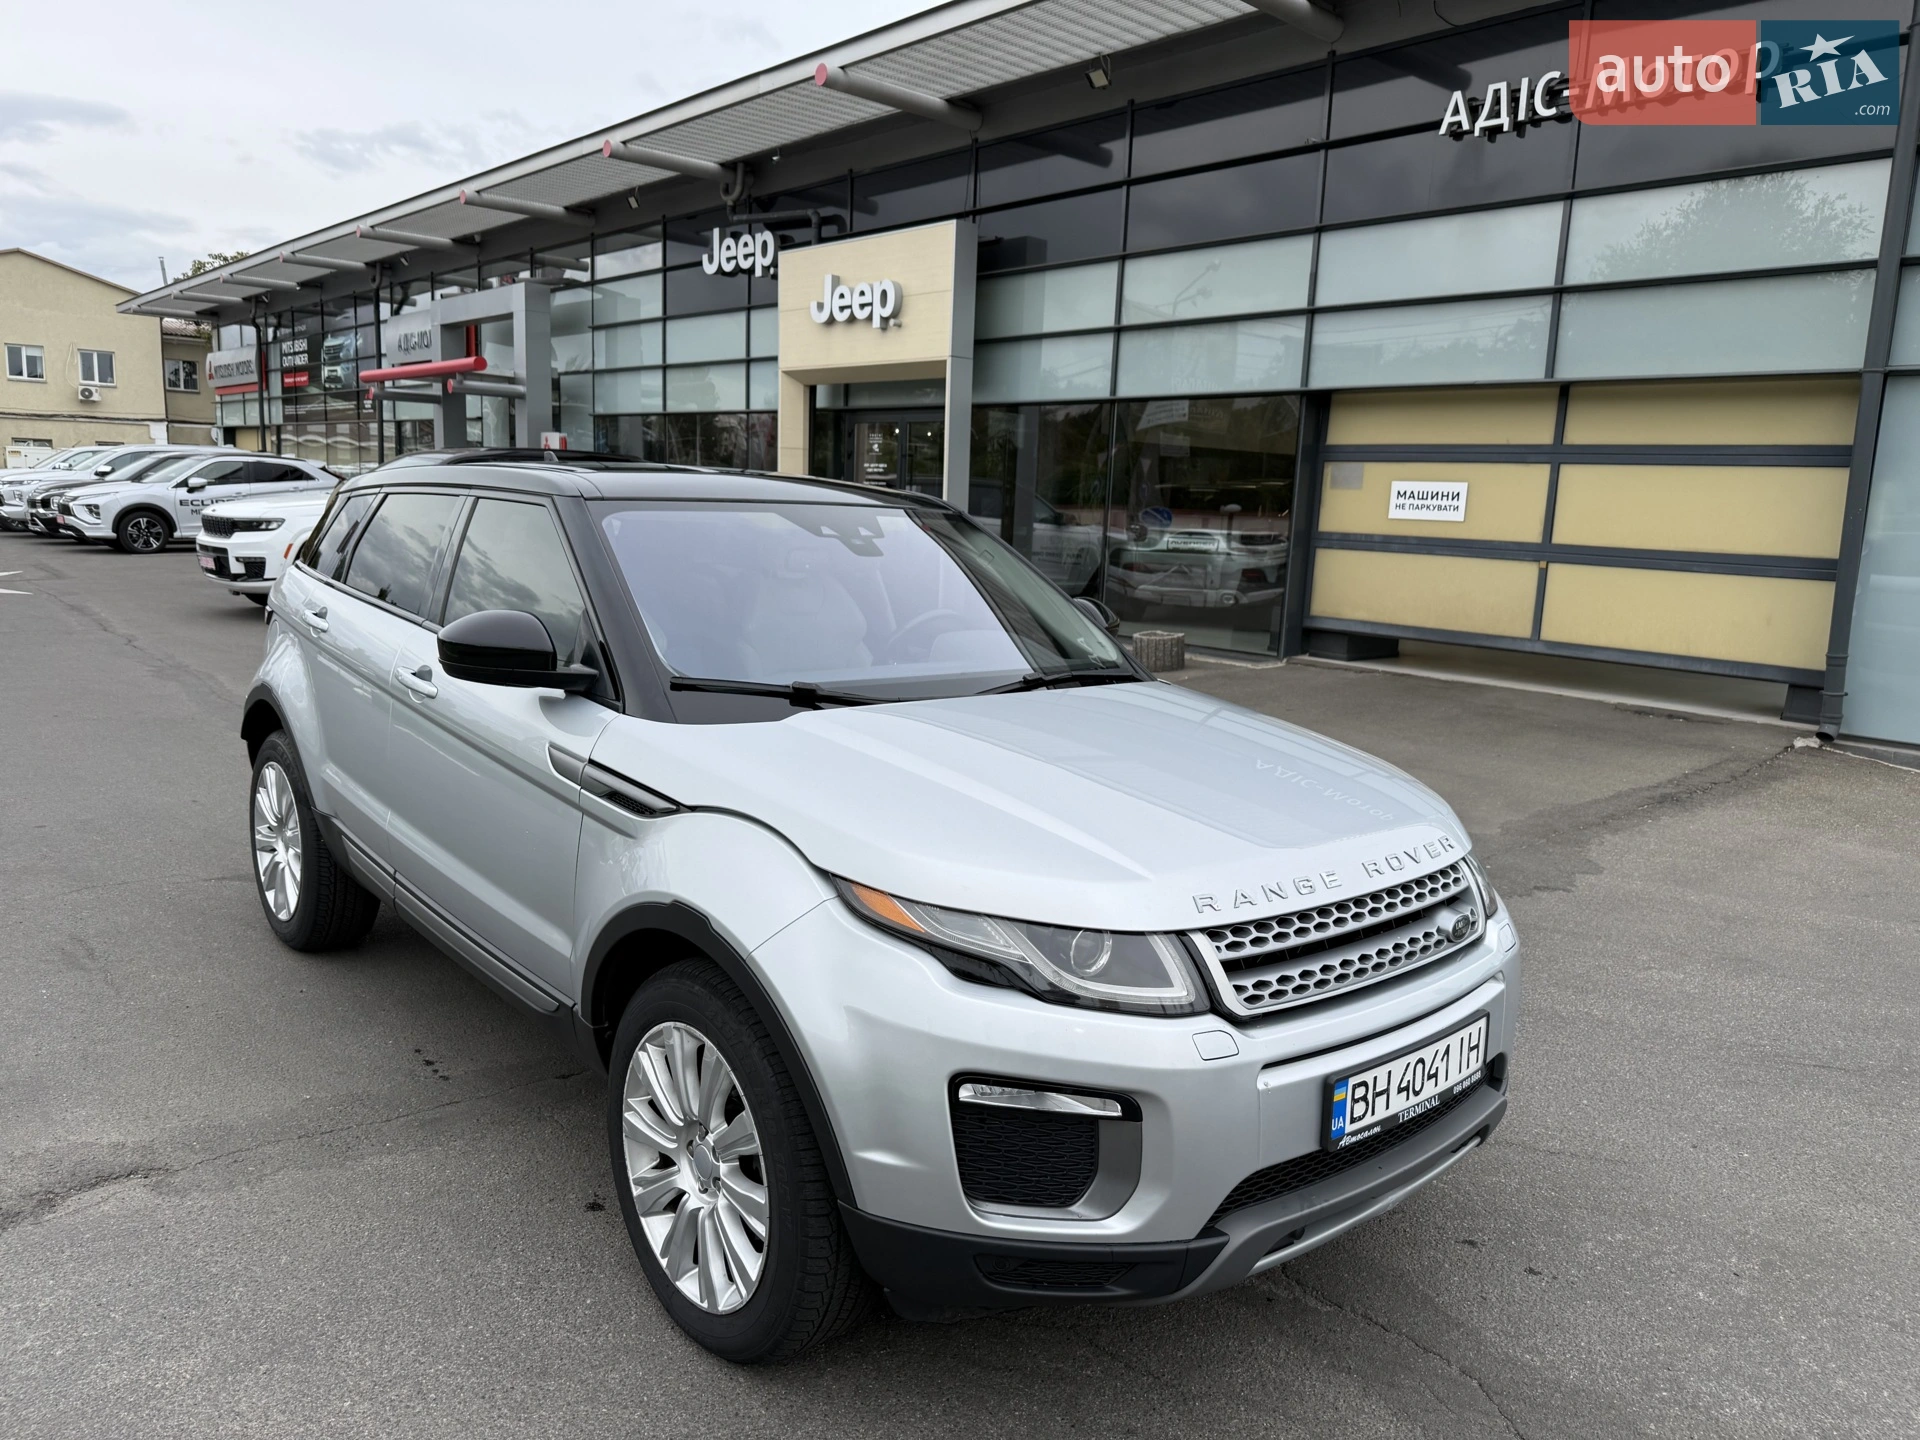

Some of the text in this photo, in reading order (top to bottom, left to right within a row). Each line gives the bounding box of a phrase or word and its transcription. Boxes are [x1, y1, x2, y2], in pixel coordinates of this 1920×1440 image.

[702, 227, 776, 278] Jeep
[810, 273, 902, 330] Jeep
[1395, 503, 1460, 512] НЕ ПАРКУВАТИ
[1397, 490, 1460, 502] МАШИНИ
[1192, 834, 1456, 914] RANGE ROVER
[1349, 1026, 1482, 1125] BH 4041 IH
[1331, 1117, 1344, 1131] UA
[1397, 1095, 1441, 1124] TERMINAL
